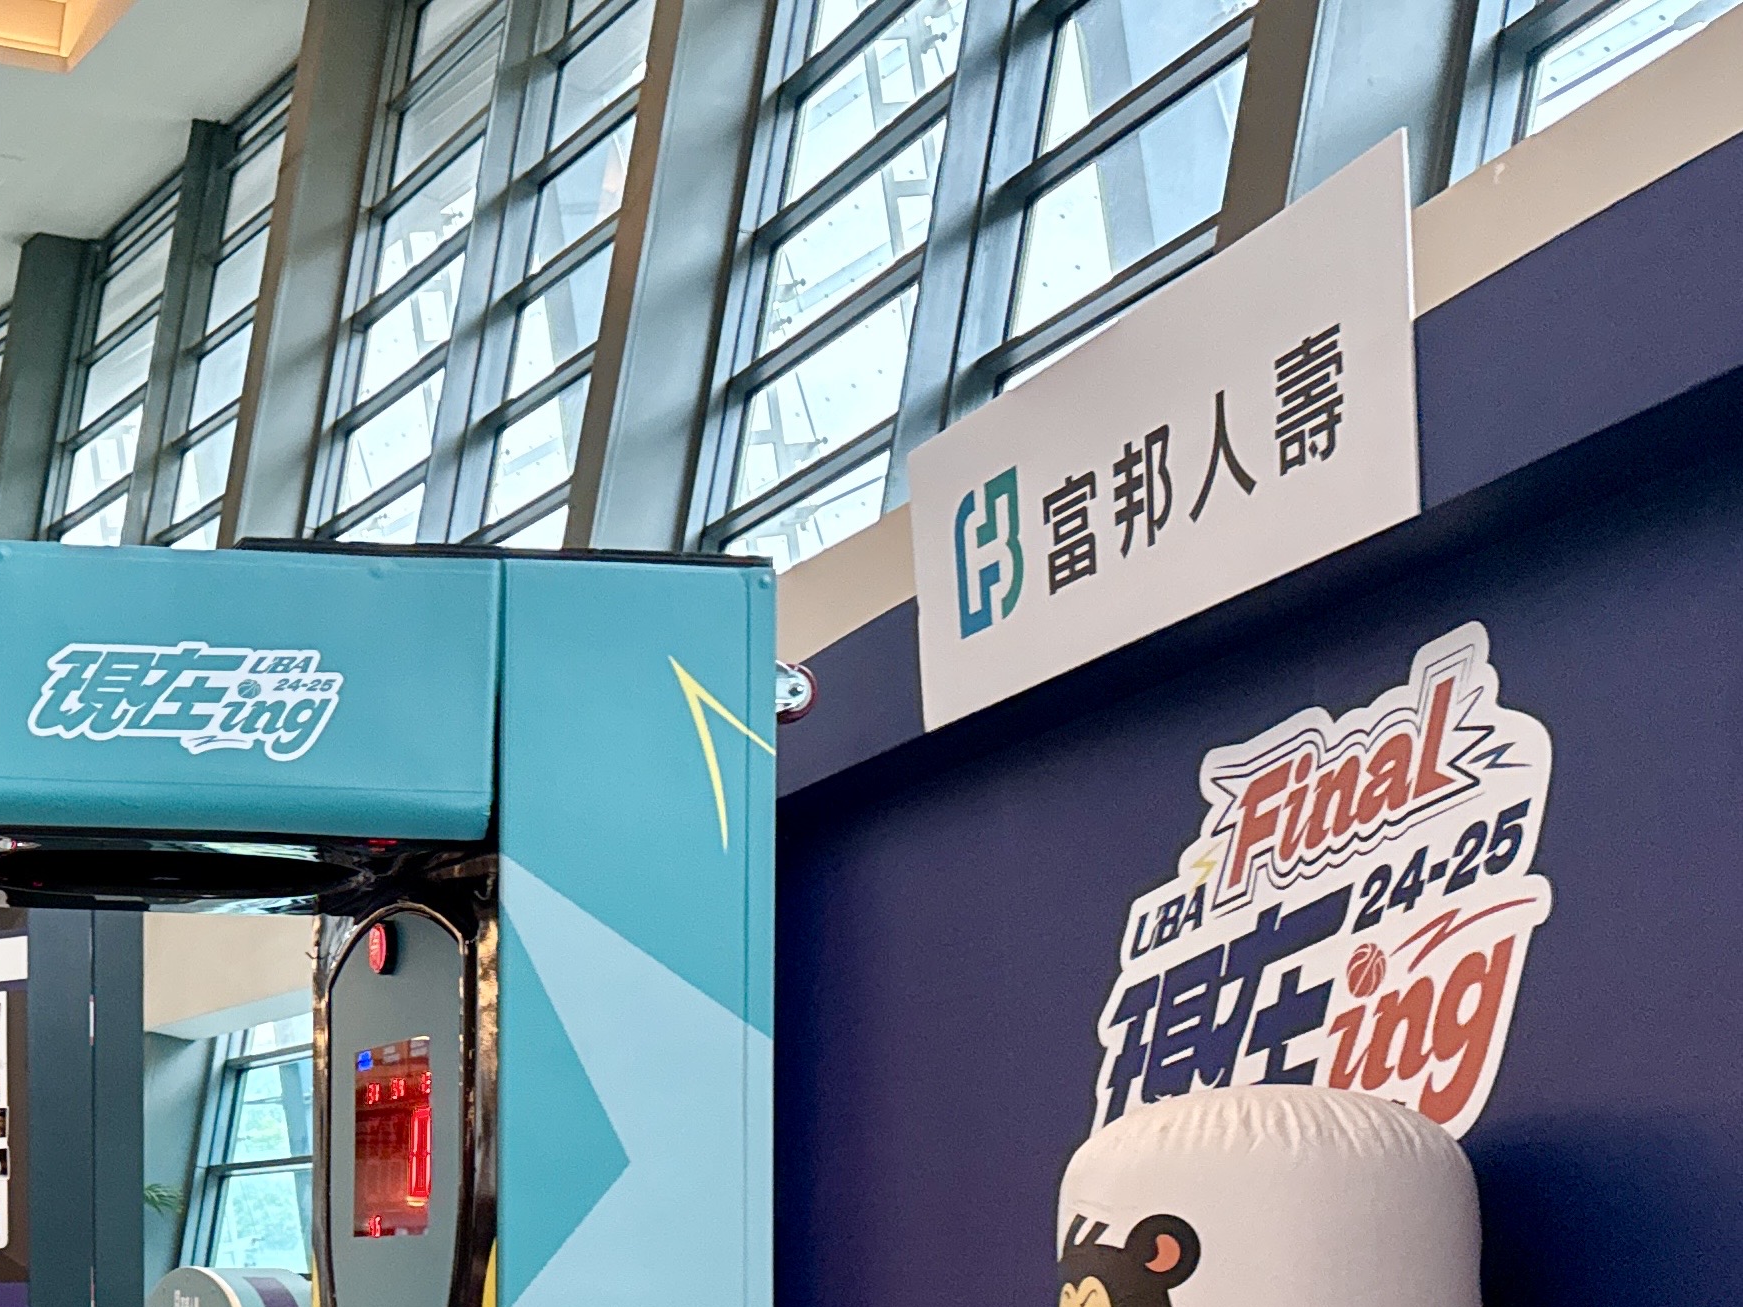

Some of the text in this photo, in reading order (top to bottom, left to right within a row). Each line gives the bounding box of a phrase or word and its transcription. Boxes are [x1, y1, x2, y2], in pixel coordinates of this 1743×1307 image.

[1042, 322, 1345, 597] 富邦人壽
[272, 677, 337, 692] 24-25
[1228, 677, 1457, 890] Final
[1352, 797, 1533, 934] 24-25
